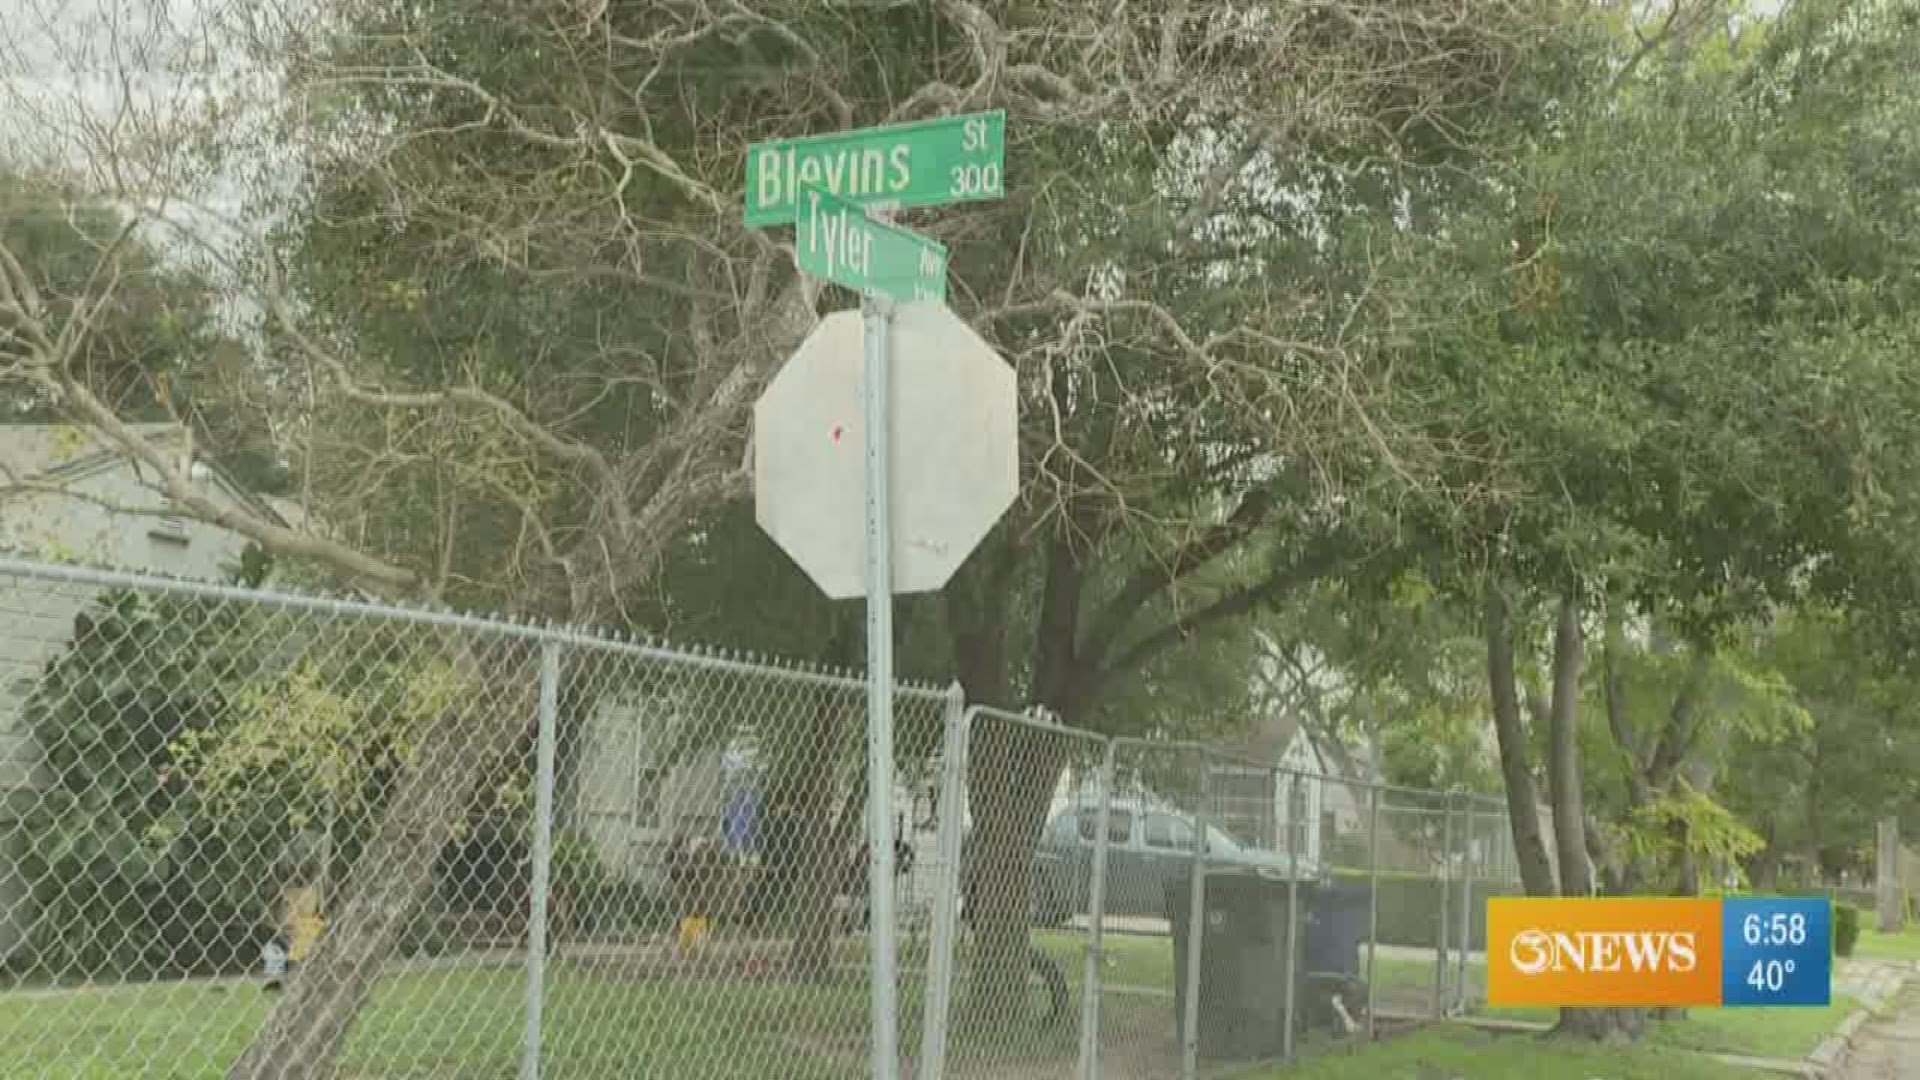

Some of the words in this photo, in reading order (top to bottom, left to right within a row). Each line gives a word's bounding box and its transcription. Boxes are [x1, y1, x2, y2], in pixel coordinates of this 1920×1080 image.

[758, 144, 910, 208] Blevins
[963, 120, 988, 151] St
[950, 163, 999, 197] 300
[808, 190, 874, 278] Tyler
